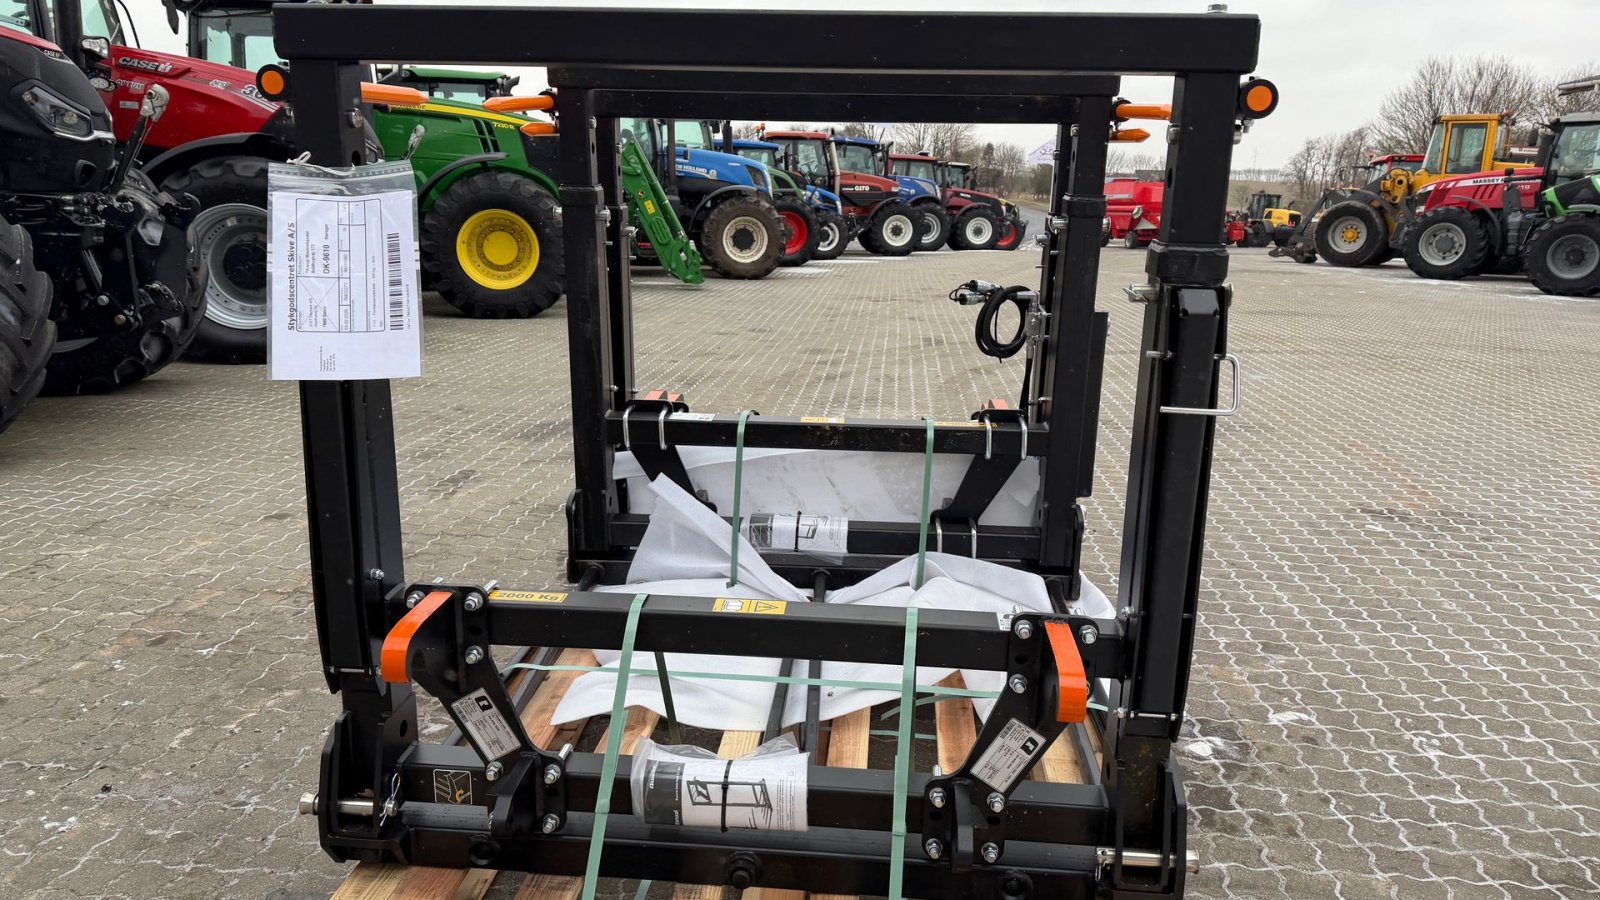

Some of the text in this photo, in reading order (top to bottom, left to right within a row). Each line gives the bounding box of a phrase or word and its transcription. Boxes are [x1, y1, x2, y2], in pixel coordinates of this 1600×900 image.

[118, 56, 156, 71] CASE
[116, 79, 145, 91] OPTUM
[683, 164, 708, 174] HOLLAND
[1472, 177, 1500, 185] MASSEY
[322, 245, 330, 274] DK-9610
[287, 222, 297, 331] Stykgodscentret Skive A/S
[497, 591, 560, 602] 2000 Kg
